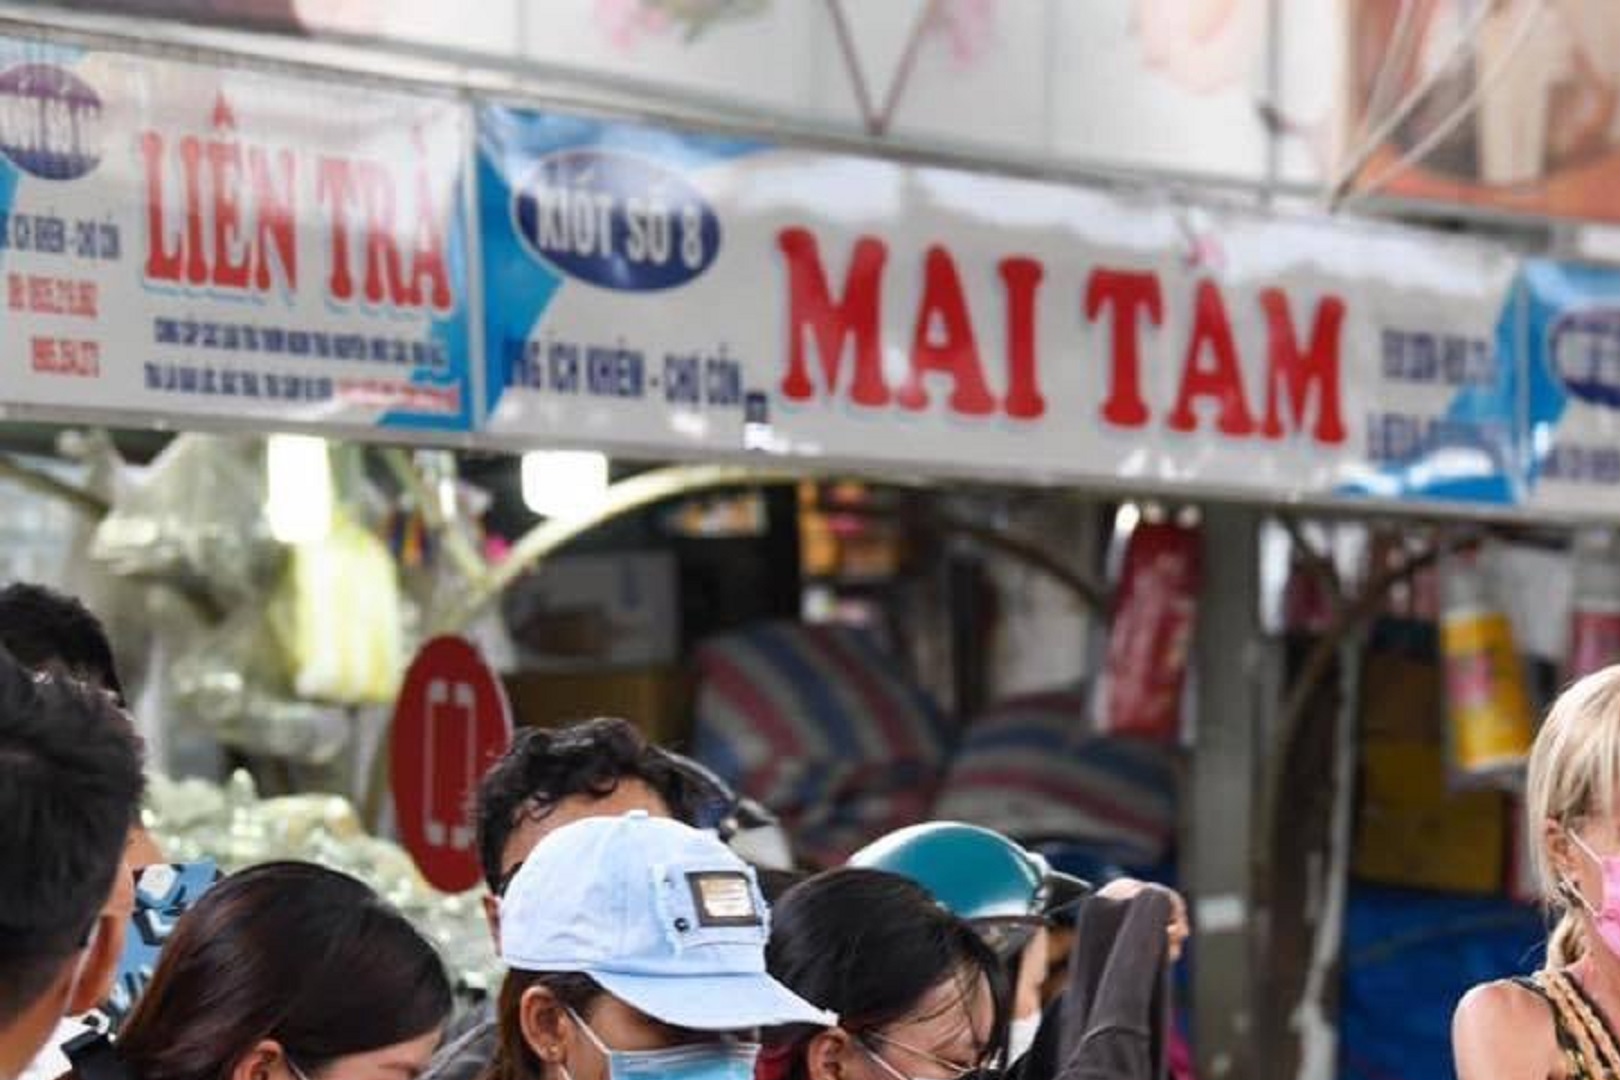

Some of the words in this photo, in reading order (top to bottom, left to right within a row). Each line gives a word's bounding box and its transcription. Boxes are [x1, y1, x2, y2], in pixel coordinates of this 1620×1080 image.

[141, 90, 296, 291] LIÊN
[681, 203, 702, 270] 8
[776, 224, 1047, 421] MAI
